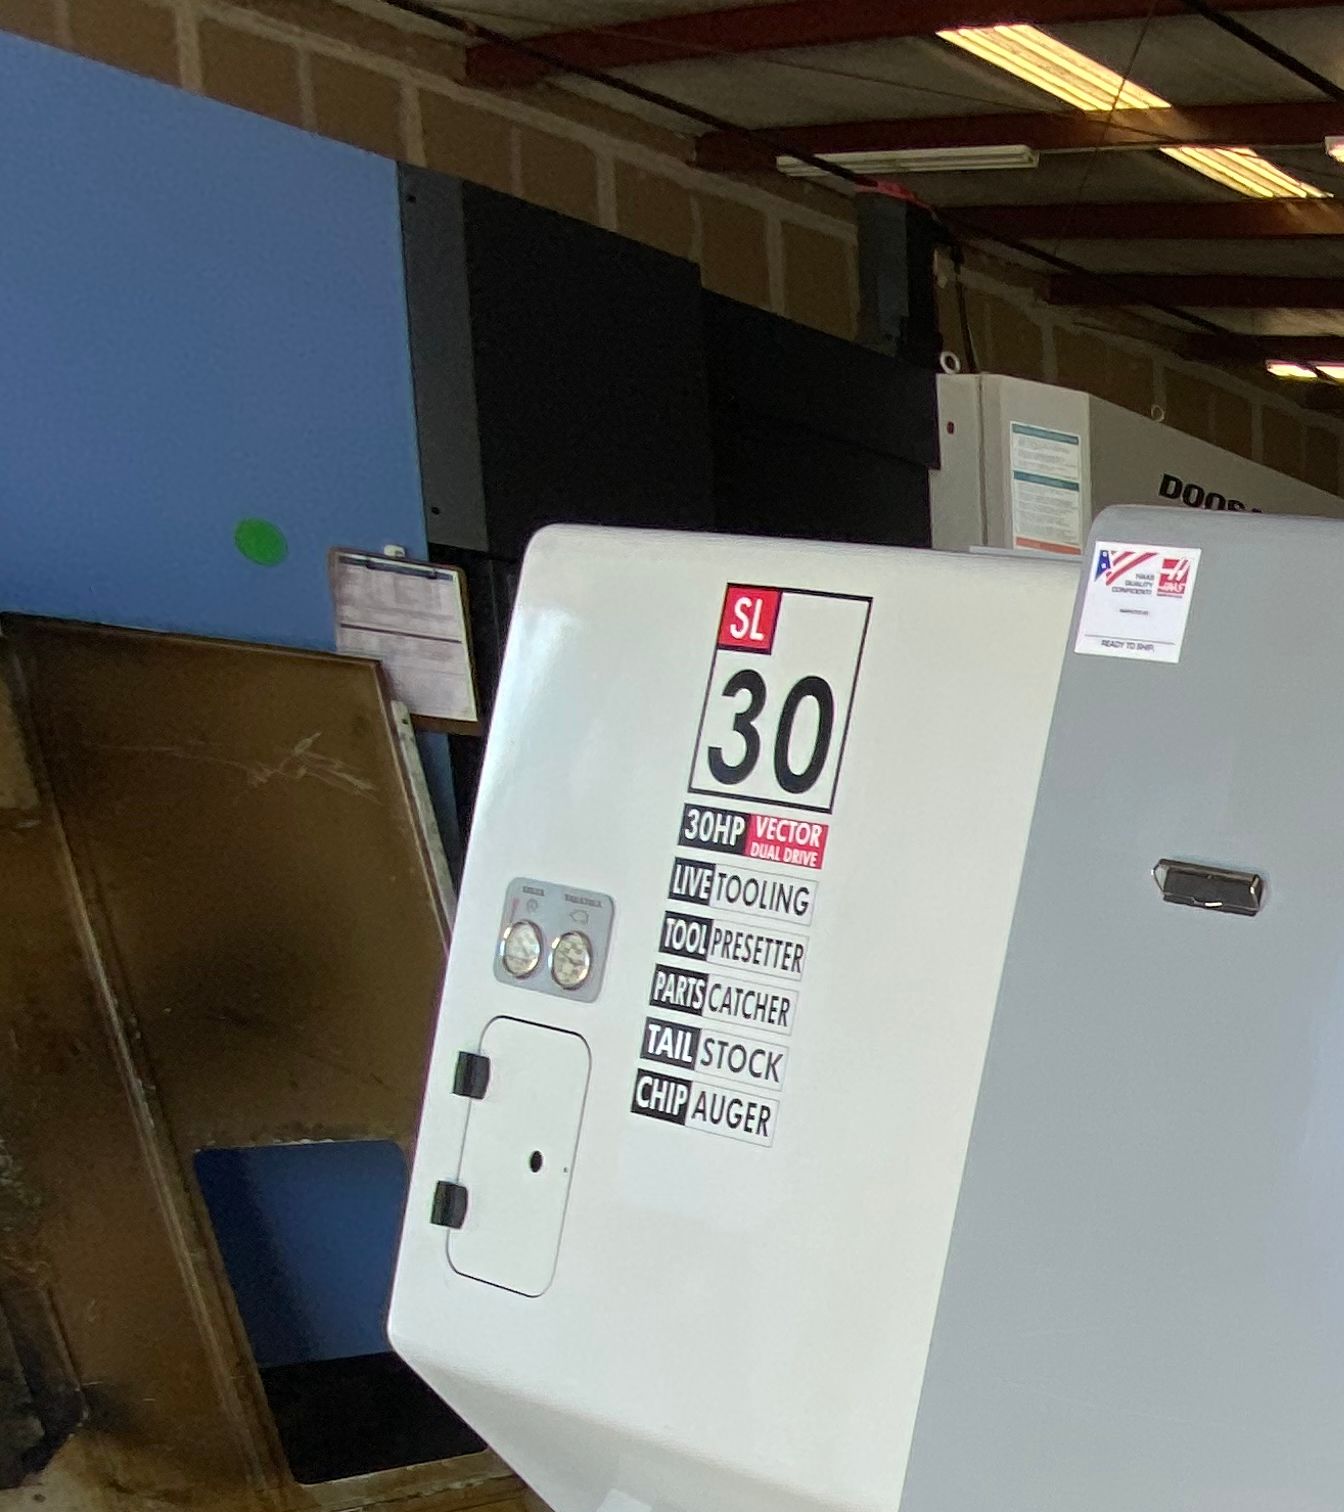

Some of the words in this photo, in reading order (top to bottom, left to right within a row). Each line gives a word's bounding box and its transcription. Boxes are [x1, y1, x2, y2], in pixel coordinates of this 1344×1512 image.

[1158, 473, 1263, 513] DOO
[730, 596, 765, 641] SL
[1126, 642, 1135, 650] TO
[708, 669, 835, 794] 30
[684, 808, 745, 847] 30HP
[754, 815, 822, 847] VECTOR
[750, 842, 782, 863] DUAL
[783, 846, 819, 868] DRIVE
[674, 862, 712, 899] LIVE
[716, 870, 811, 918] TOOLING
[664, 916, 708, 954] TOOL
[712, 928, 803, 974] PRESETTER
[654, 969, 706, 1010] PARTS
[707, 982, 792, 1028] CATCHER
[645, 1024, 694, 1065] TAIL
[700, 1037, 784, 1084] STOCK
[635, 1074, 688, 1118] CHIP
[691, 1089, 772, 1138] AUGER
